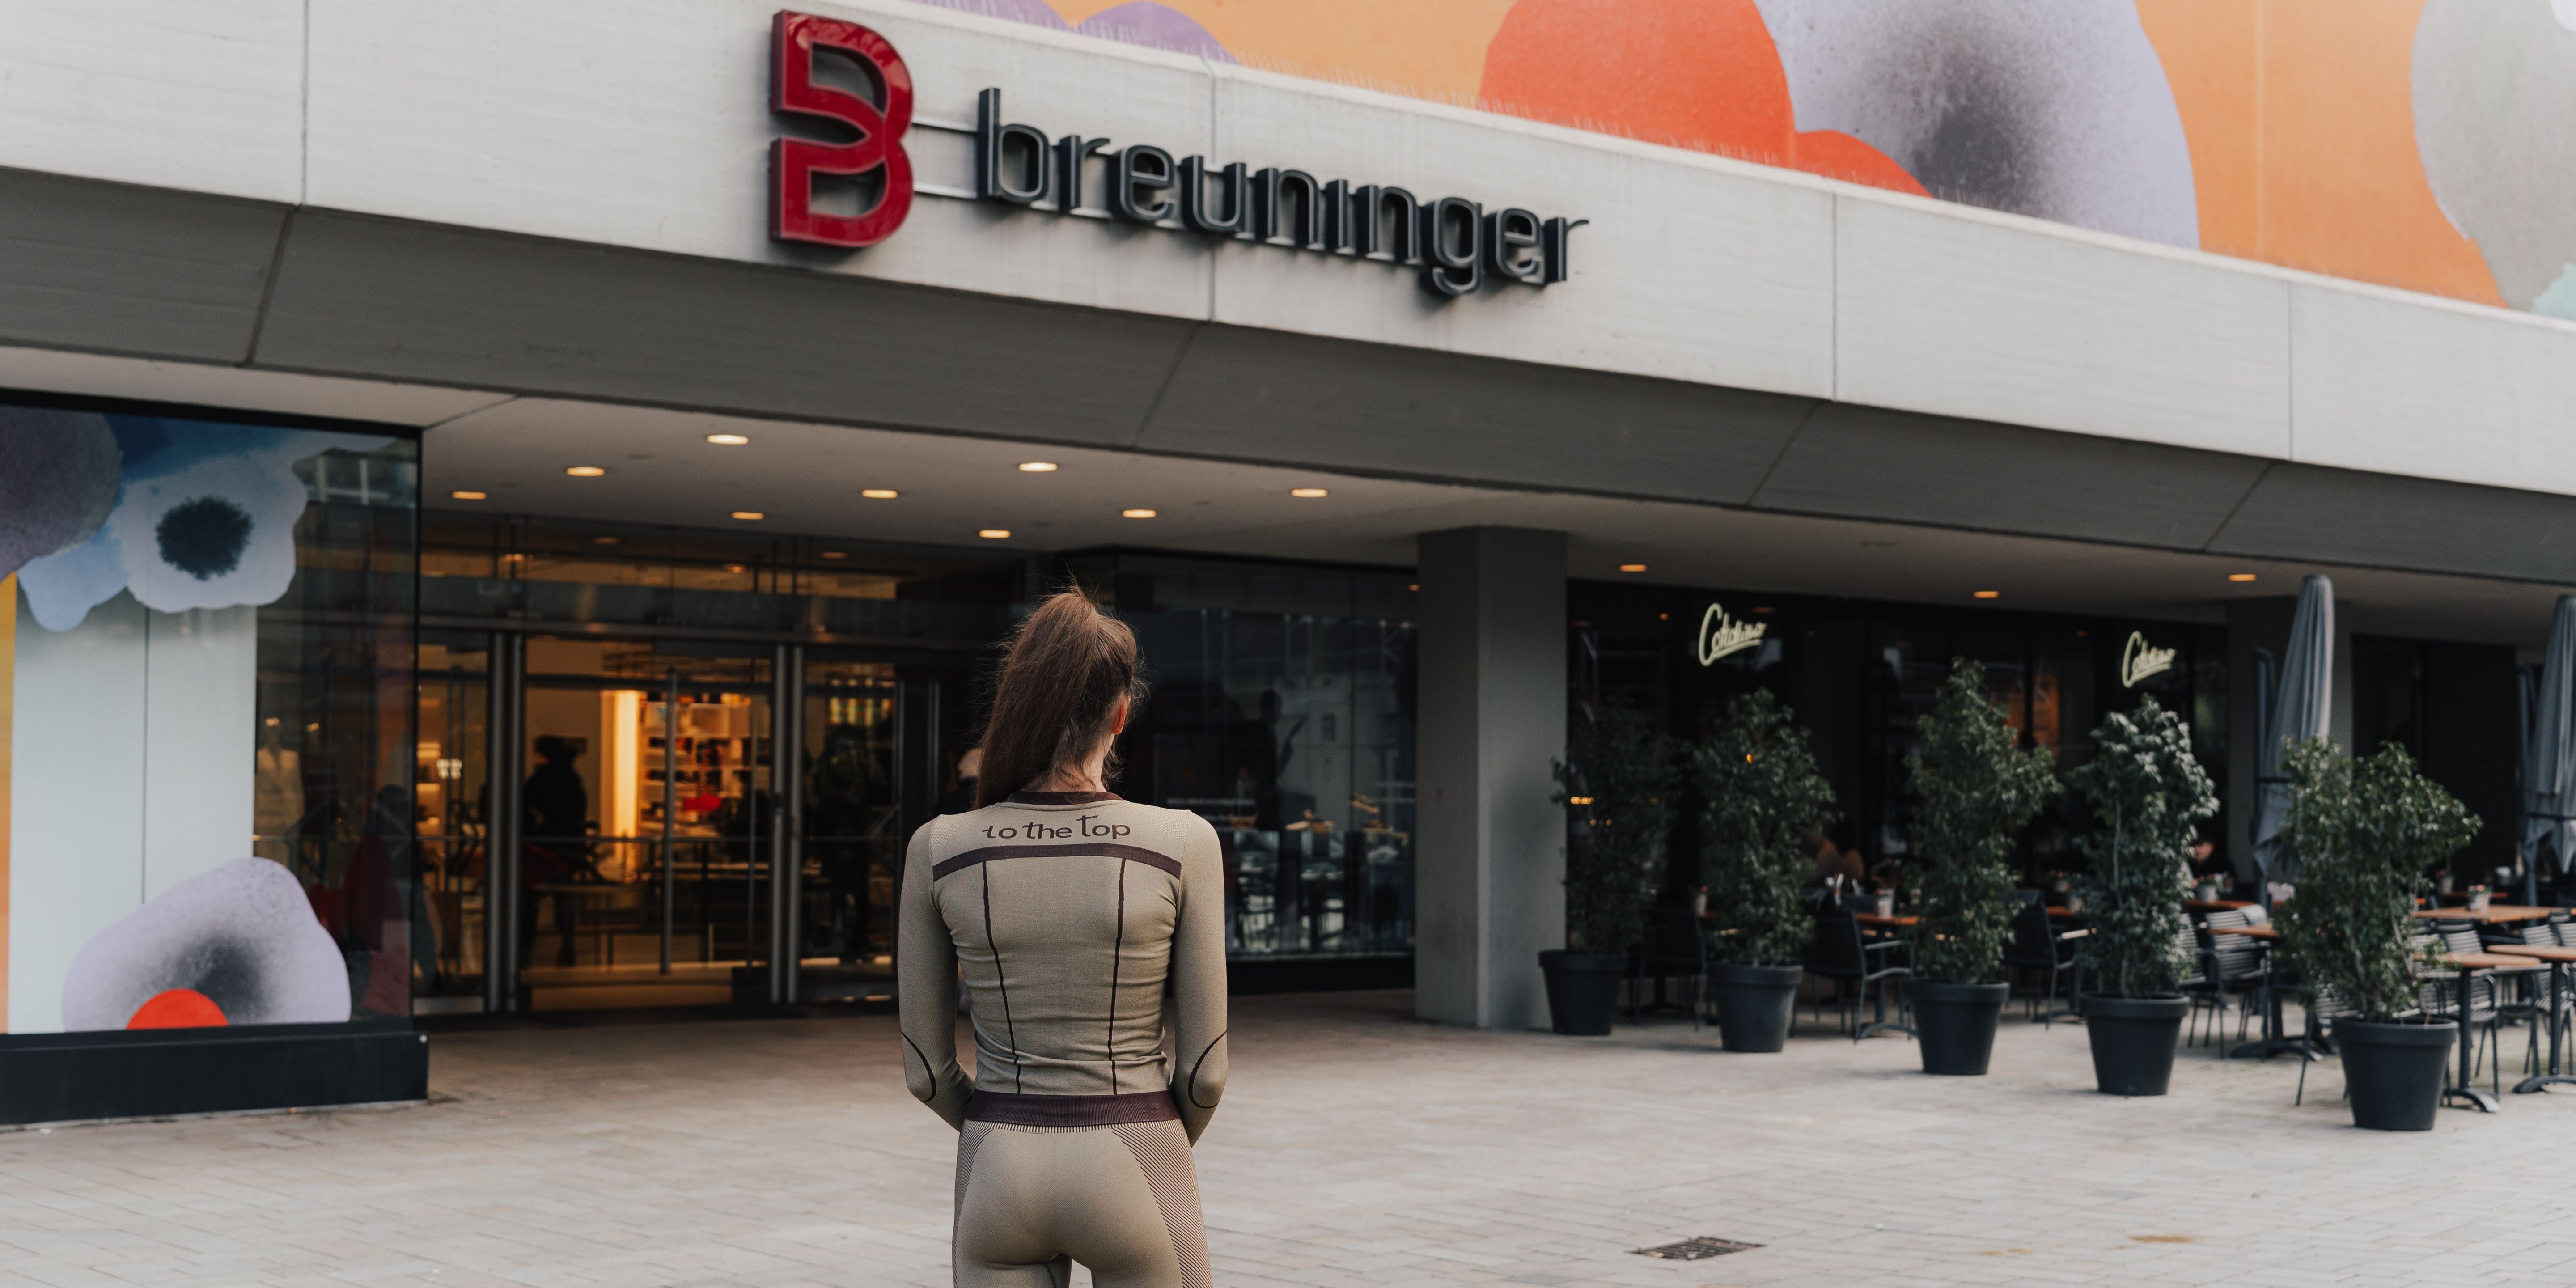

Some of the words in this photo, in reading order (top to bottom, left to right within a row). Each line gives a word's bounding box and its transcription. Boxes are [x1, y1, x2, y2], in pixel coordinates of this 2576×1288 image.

[977, 87, 1589, 296] breuninger
[982, 826, 1017, 839] to
[1022, 822, 1072, 839] the
